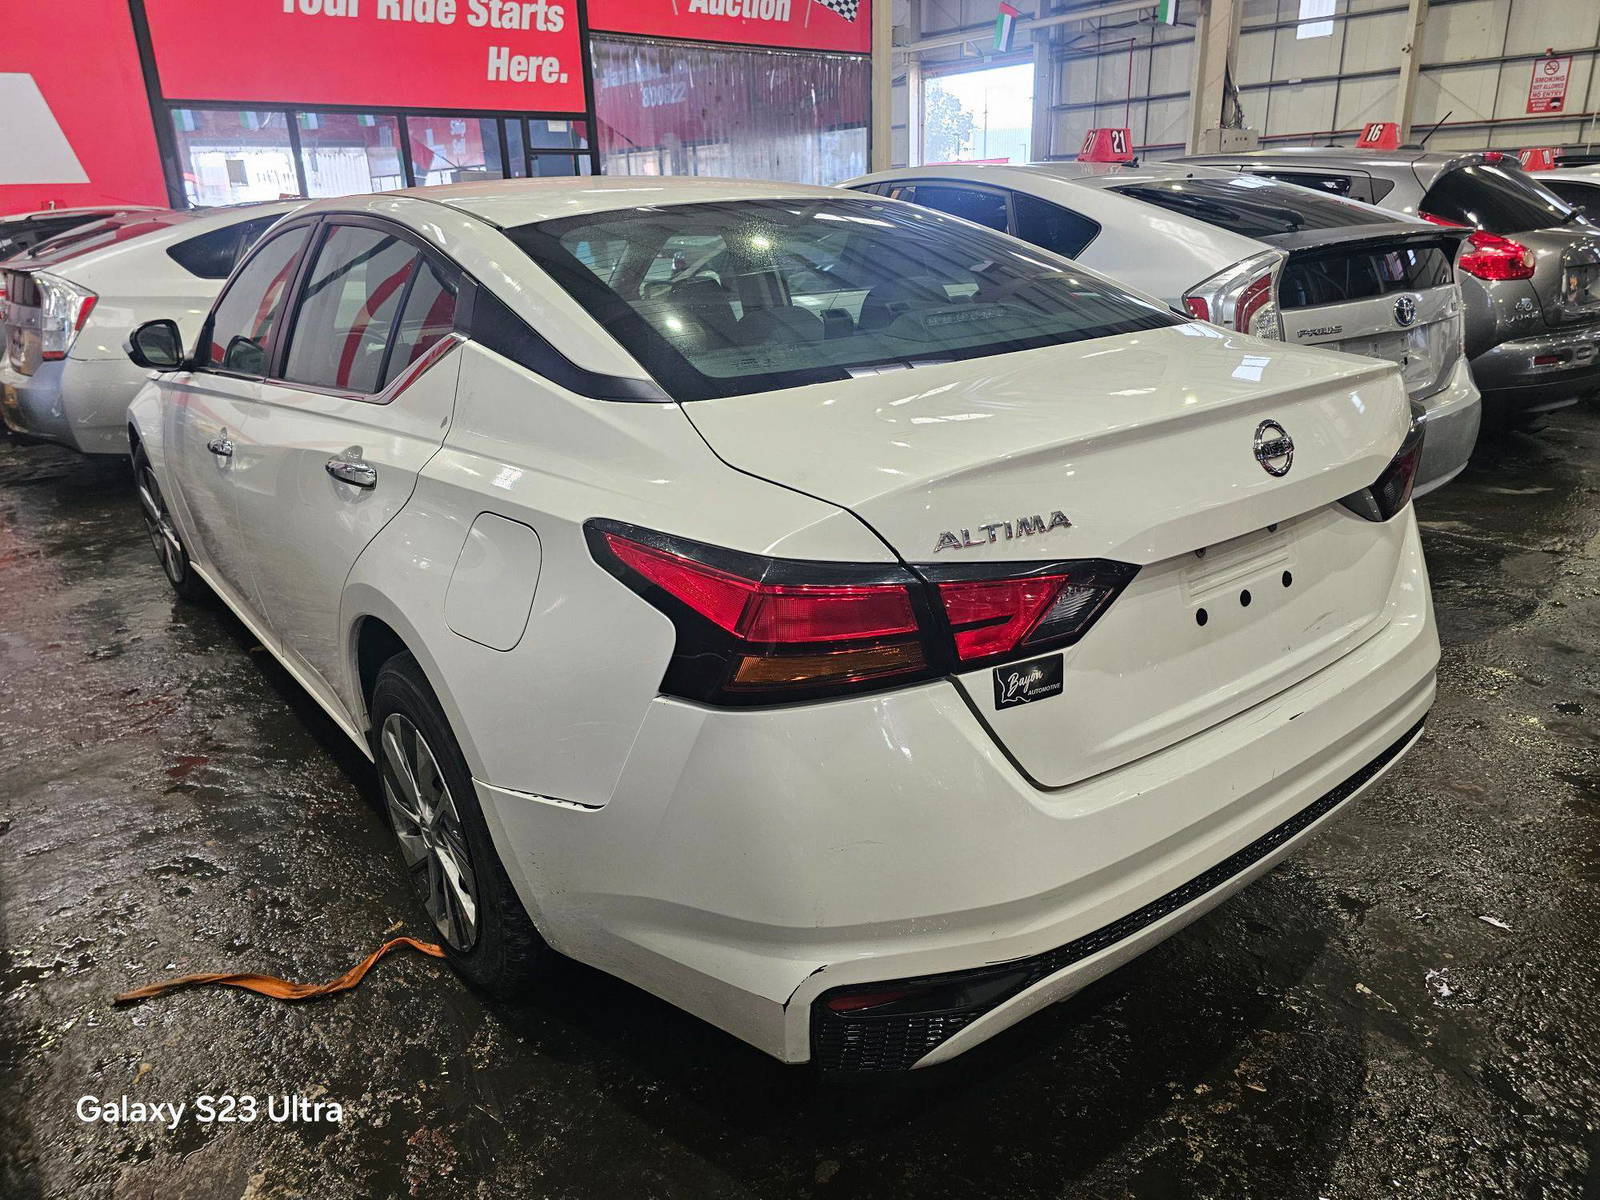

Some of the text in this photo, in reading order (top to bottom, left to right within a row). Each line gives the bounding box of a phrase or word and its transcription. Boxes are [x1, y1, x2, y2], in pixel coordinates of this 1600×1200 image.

[377, 0, 457, 24] Ride
[466, 0, 564, 33] Starts
[487, 46, 569, 84] Here.
[1111, 130, 1126, 153] 21
[1366, 123, 1384, 142] 16
[934, 510, 1072, 553] ALTIMA
[1027, 682, 1061, 697] AUTOMOTIVE
